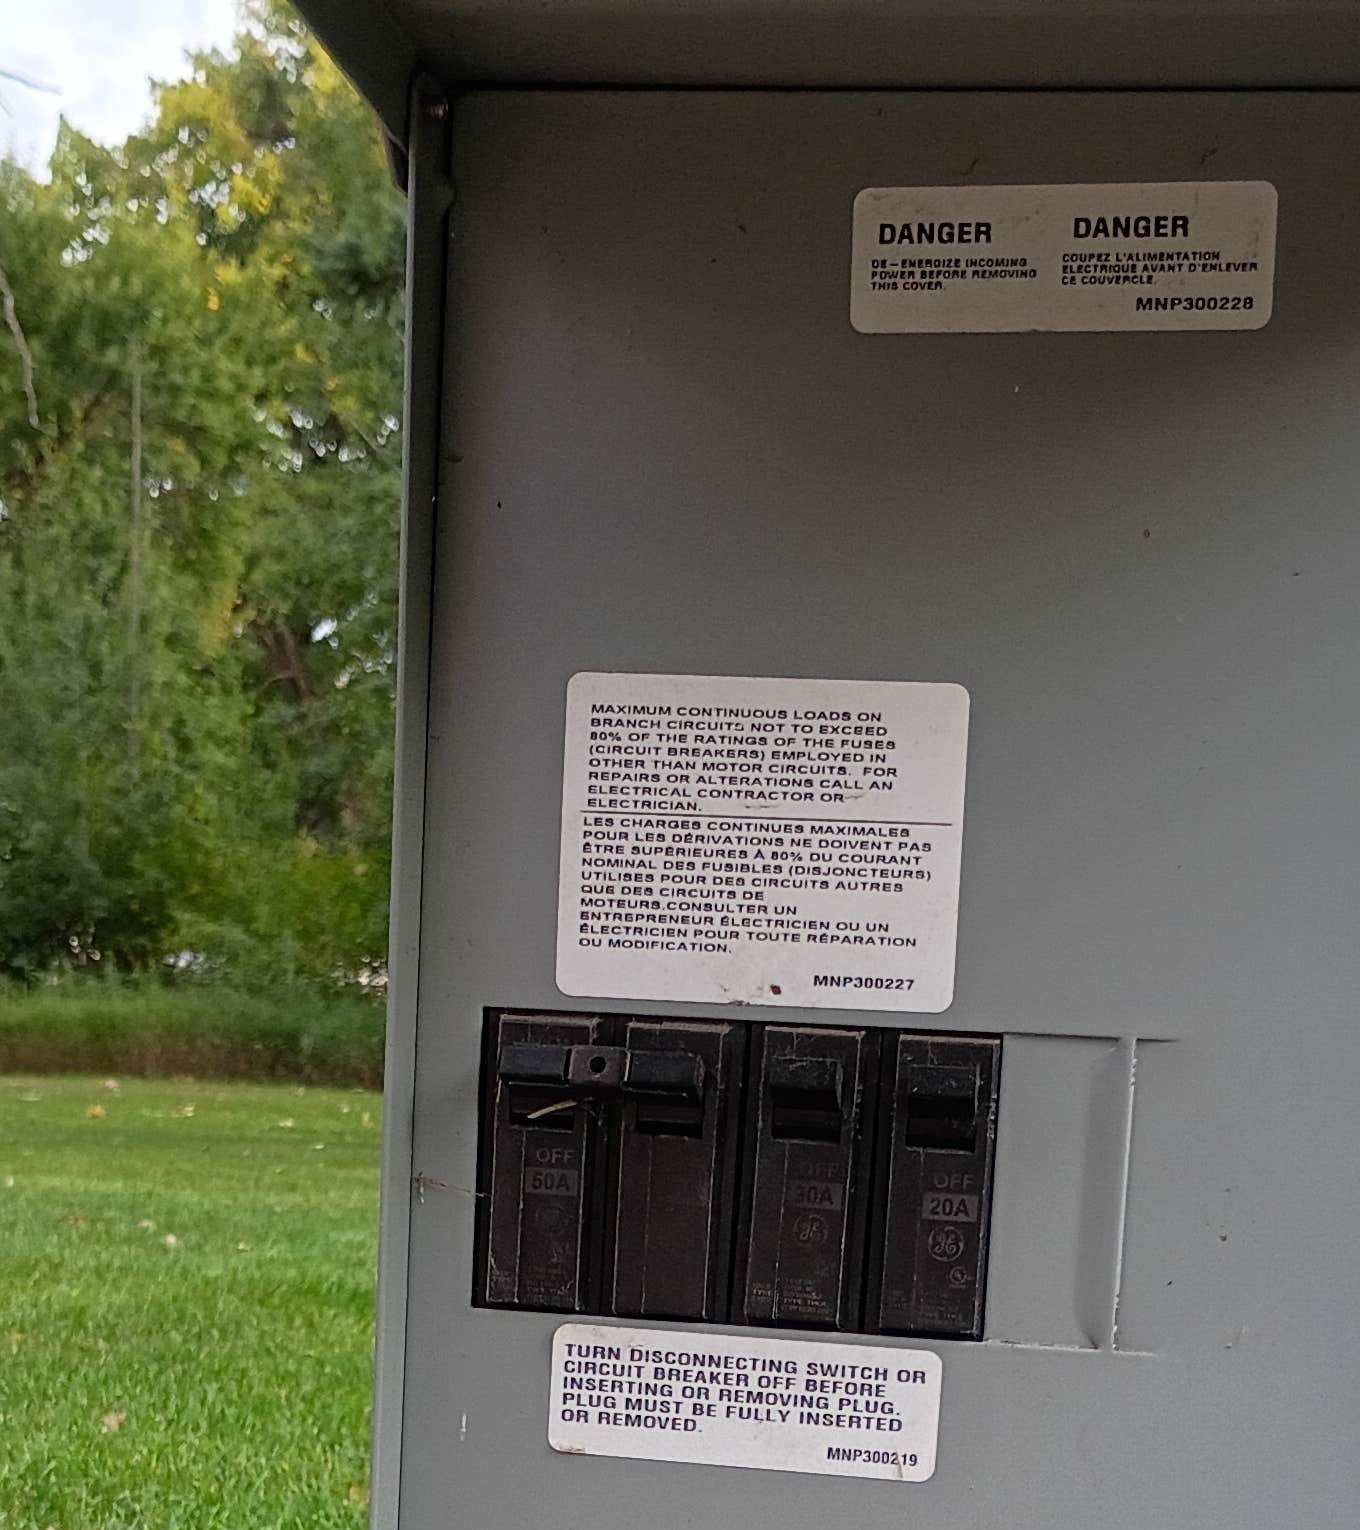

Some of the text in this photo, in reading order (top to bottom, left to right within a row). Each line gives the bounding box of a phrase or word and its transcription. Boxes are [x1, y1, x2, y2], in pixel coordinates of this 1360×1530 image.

[878, 221, 992, 245] DANGER
[1073, 215, 1189, 239] DANGER
[965, 257, 1028, 268] INCOMING
[1062, 250, 1221, 264] COUPEZ L'ALIMENTATION
[871, 268, 1037, 281] POWER BEFORE REMOVING
[1061, 261, 1258, 275] ELECTRIQUE AVANT D'ENLEVER
[870, 280, 899, 291] THIS
[1061, 275, 1077, 286] CE
[1135, 296, 1254, 312] MNP300228
[591, 703, 882, 724] MAXIMUM CONTINUOUS LOADS ON
[590, 716, 888, 737] BRANCH CIRCUITS NOT TO EXCEED
[589, 730, 896, 751] 80% OF THE RATINGS OF THE FUSES
[588, 742, 887, 764] (CIRCUIT BREAKERS) EMPLOYED IN
[588, 757, 898, 778] OTHER THAN MOTOR CIRCUITS. FOR
[588, 770, 893, 791] REPAIRS OR ALTERATIONS CALL AN
[587, 784, 847, 804] ELECTRICAL CONTRACTOR OR
[587, 797, 702, 812] ELECTRICIAN.
[583, 815, 910, 838] LES CHARGES CONTINUES MAXIMALES
[582, 829, 932, 853] POUR LES DÉRIVATIONS NE DOIVENT PAS
[770, 850, 804, 863] 80%
[809, 851, 833, 863] DU
[837, 852, 923, 866] COURANT
[581, 856, 932, 883] NOMINAL DES FUSIBLES (DISJONCTEURS)
[581, 870, 904, 893] UTILISES POUR DES CIRCUITS AUTRES
[580, 883, 765, 902] QUE DES CIRCUITS DE
[579, 908, 715, 927] ENTREPRENEUR
[835, 921, 860, 932] OU
[865, 922, 889, 933] UN
[773, 905, 797, 916] UN
[578, 937, 732, 954] OU MODIFICATION.
[693, 928, 741, 941] POUR
[745, 930, 801, 943] TOUTE
[806, 931, 917, 948] RÉPARATION
[813, 974, 915, 991] MNP300227
[535, 1147, 576, 1165] OFF
[531, 1171, 571, 1192] 50A
[933, 1173, 976, 1190] OFF
[929, 1196, 970, 1218] 20A
[564, 1343, 926, 1385] TURN DISCONNECTING SWITCH OR
[563, 1359, 887, 1399] CIRCUIT BREAKER OFF BEFORE
[563, 1375, 900, 1417] INSERTING OR REMOVING PLUG.
[560, 1408, 703, 1433] OR REMOVED.
[562, 1391, 903, 1432] PLUG MUST BE FULLY INSERTED
[826, 1446, 918, 1468] MNP300219
